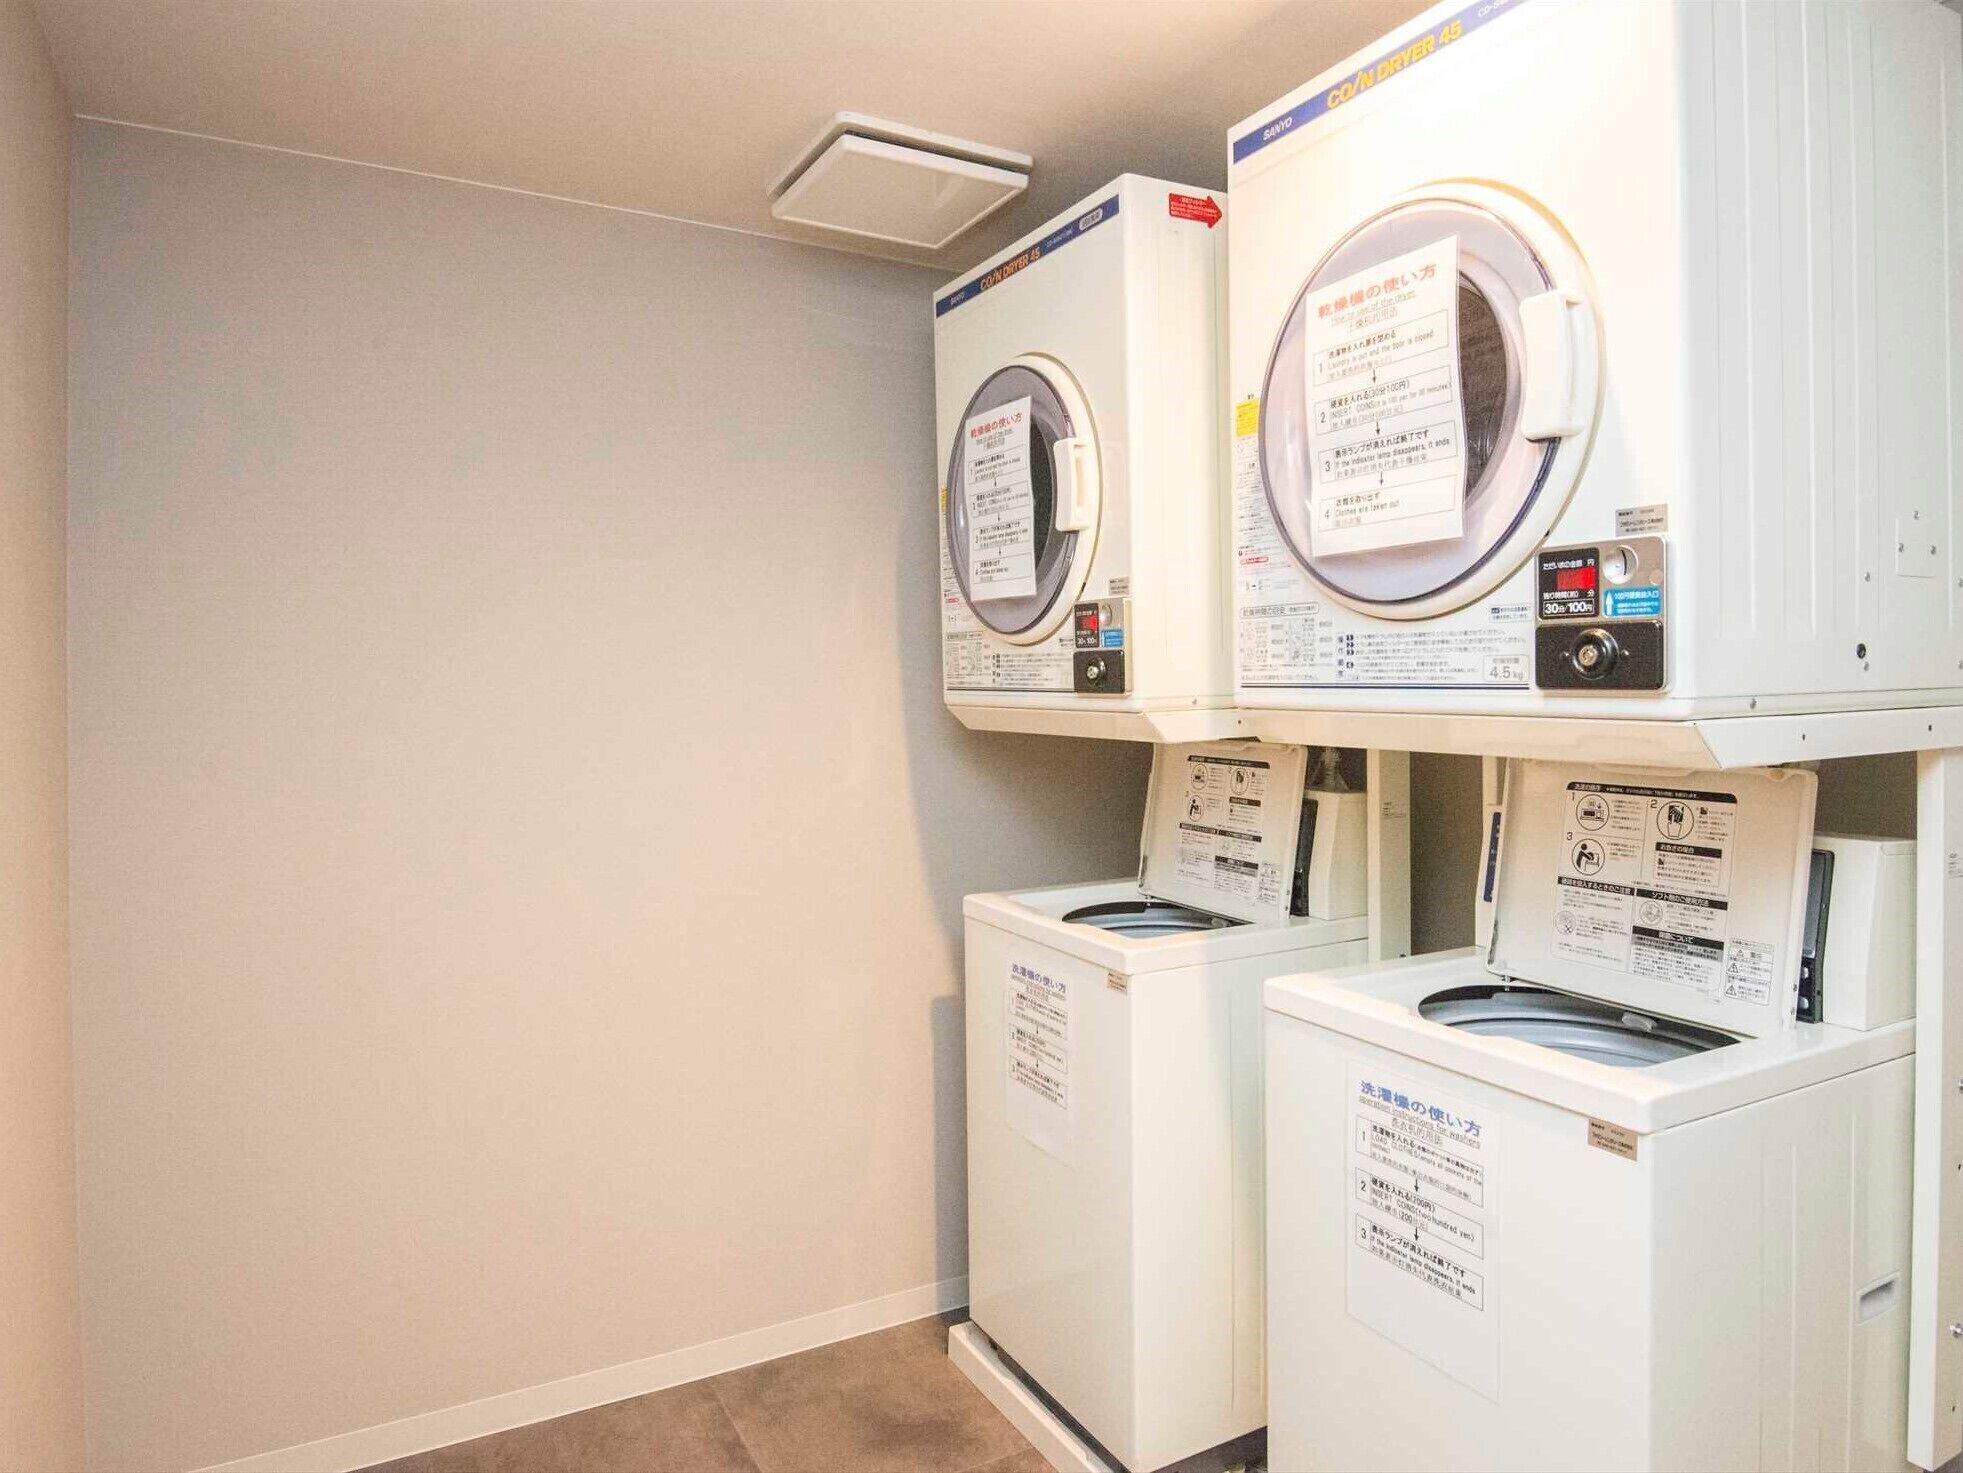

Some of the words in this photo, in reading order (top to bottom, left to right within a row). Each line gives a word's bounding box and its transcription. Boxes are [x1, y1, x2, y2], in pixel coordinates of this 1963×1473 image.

[1377, 35, 1435, 82] DRYER
[1439, 20, 1462, 45] 45
[1263, 117, 1293, 141] SANYO
[1318, 264, 1436, 319] 乾燥機の使い方
[1320, 412, 1326, 423] 2
[1325, 461, 1330, 472] 3
[1325, 510, 1329, 519] 4
[1490, 666, 1511, 679] 4.5
[1513, 669, 1524, 680] kg
[1651, 800, 1657, 809] 2
[1567, 832, 1572, 841] 3
[1360, 1080, 1482, 1137] 洗濯機の使い方
[1361, 1181, 1366, 1192] 2
[1361, 1228, 1366, 1239] 3
[1372, 1224, 1465, 1277] 表示ランプが消えれば終了です
